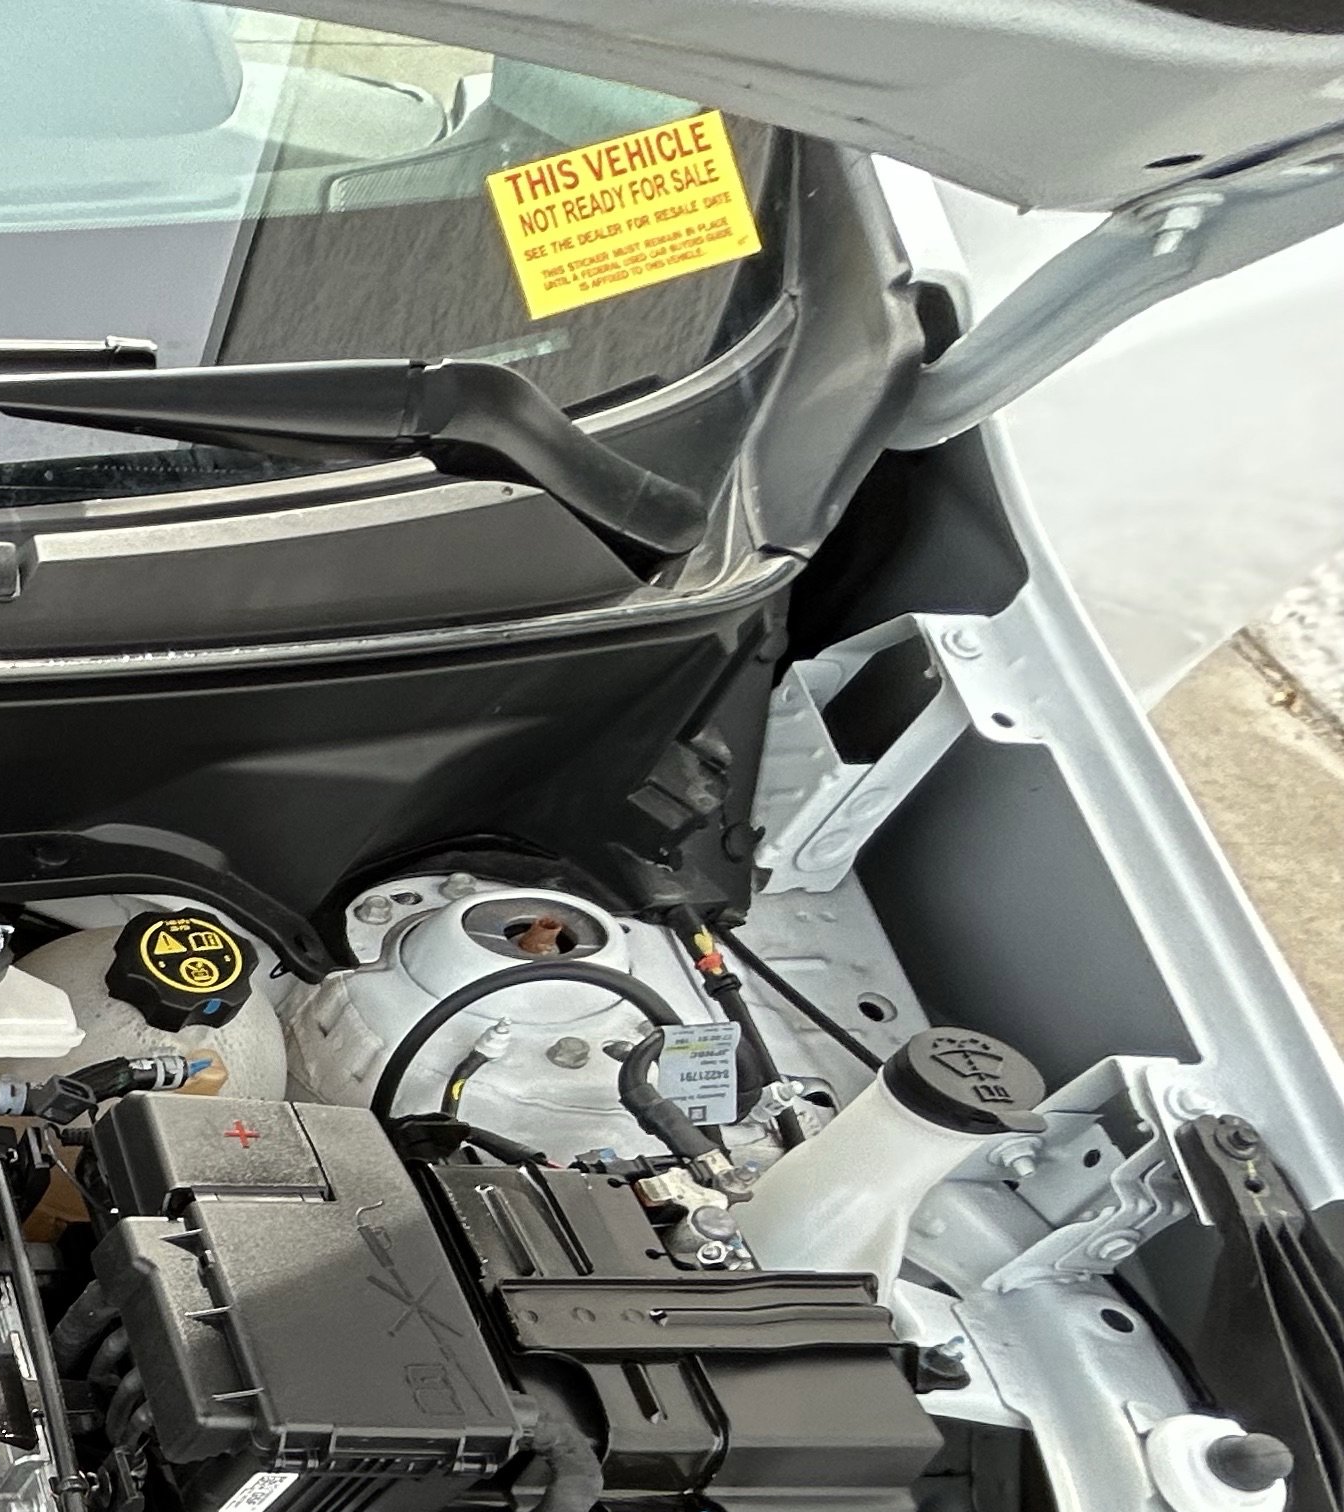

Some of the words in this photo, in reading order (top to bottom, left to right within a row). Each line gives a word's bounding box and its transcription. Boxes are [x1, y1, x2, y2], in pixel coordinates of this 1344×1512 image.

[504, 159, 579, 204] THIS
[582, 121, 712, 181] VEHICLE
[519, 204, 558, 237] NOT
[562, 185, 625, 224] READY
[629, 174, 670, 205] FOR
[671, 159, 720, 192] SALE
[524, 245, 548, 261] SEE
[550, 237, 574, 253] THE
[577, 223, 622, 245] DEALER
[626, 215, 650, 230] FOR
[654, 200, 698, 222] RESALE
[703, 191, 732, 209] DATE
